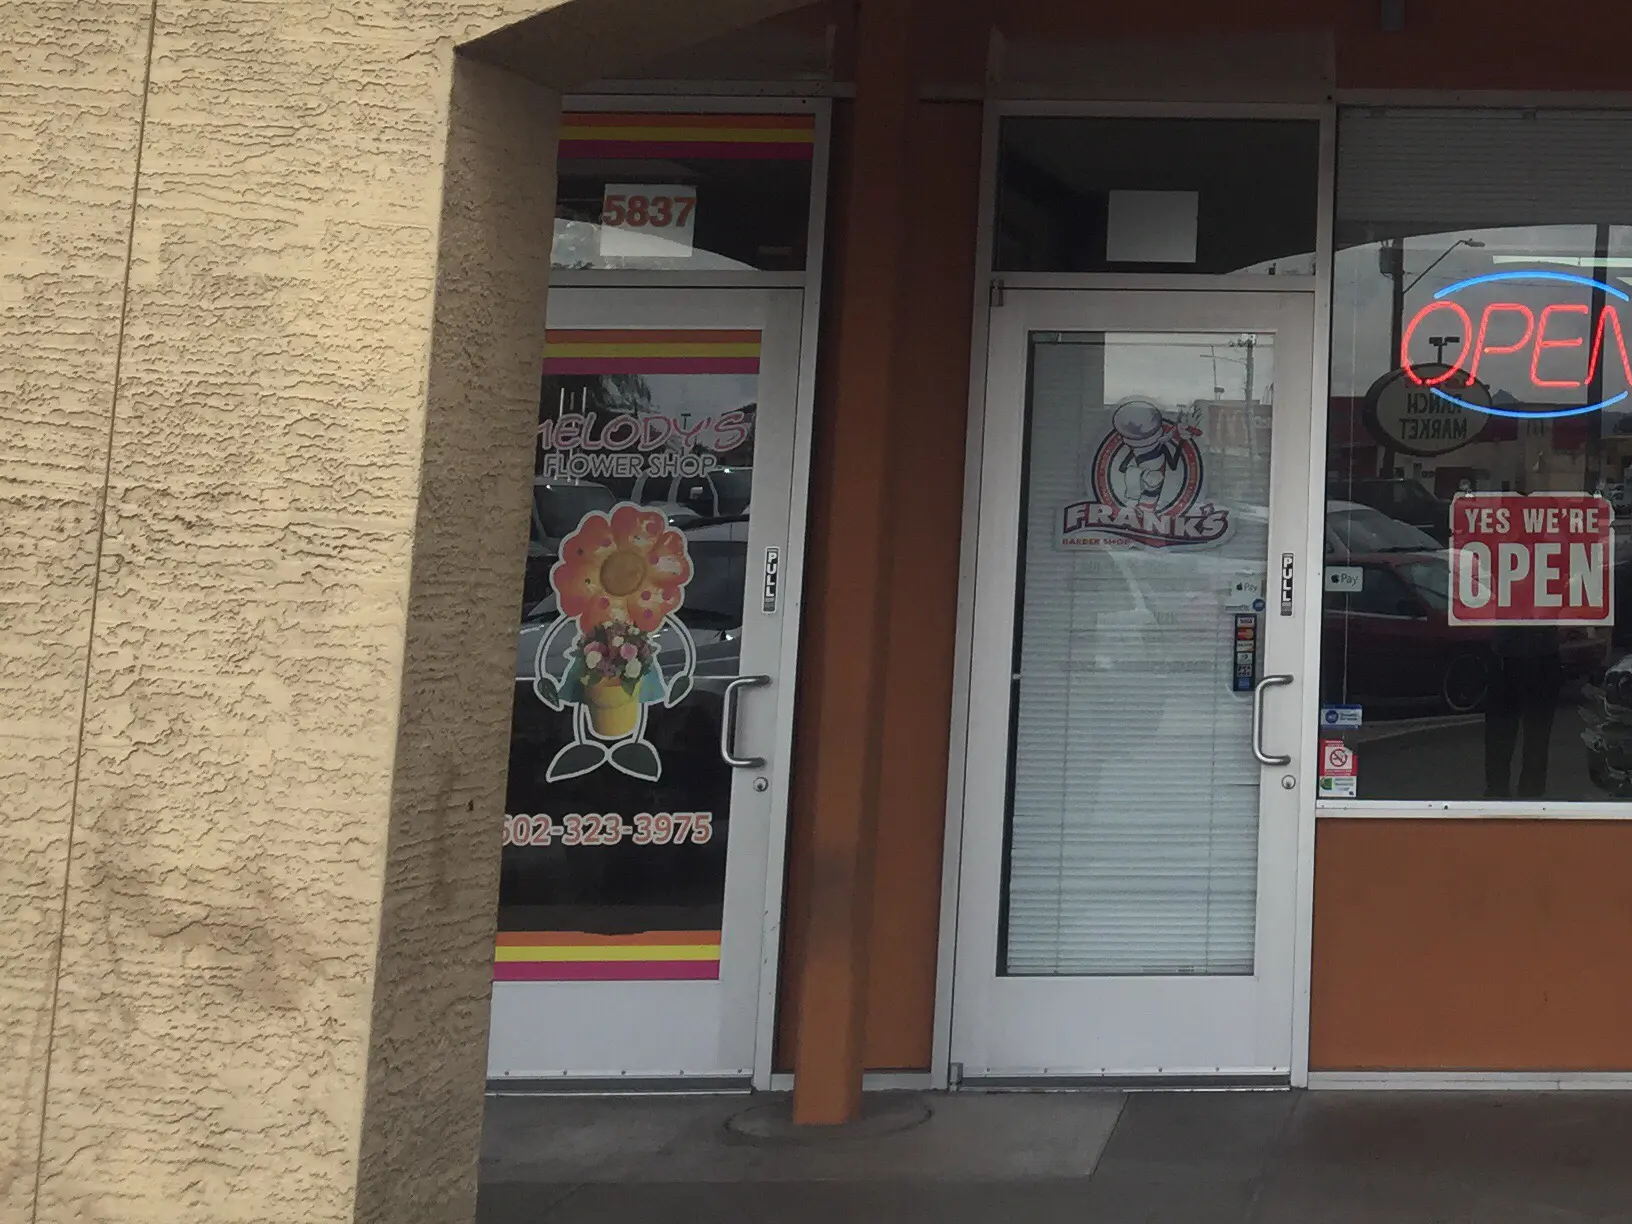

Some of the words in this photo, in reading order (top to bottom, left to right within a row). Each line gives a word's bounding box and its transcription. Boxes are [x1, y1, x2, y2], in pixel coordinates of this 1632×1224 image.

[602, 194, 697, 228] 5837
[543, 453, 644, 478] FLOWER
[647, 453, 718, 478] SHOP
[1063, 504, 1230, 539] FRANK'S
[1464, 509, 1510, 534] YES
[1523, 508, 1600, 533] WE'RE
[765, 552, 777, 597] PULL
[1243, 583, 1258, 592] Pay
[1282, 557, 1293, 602] PULL
[1340, 574, 1359, 587] Pay
[1459, 541, 1604, 608] OPEN
